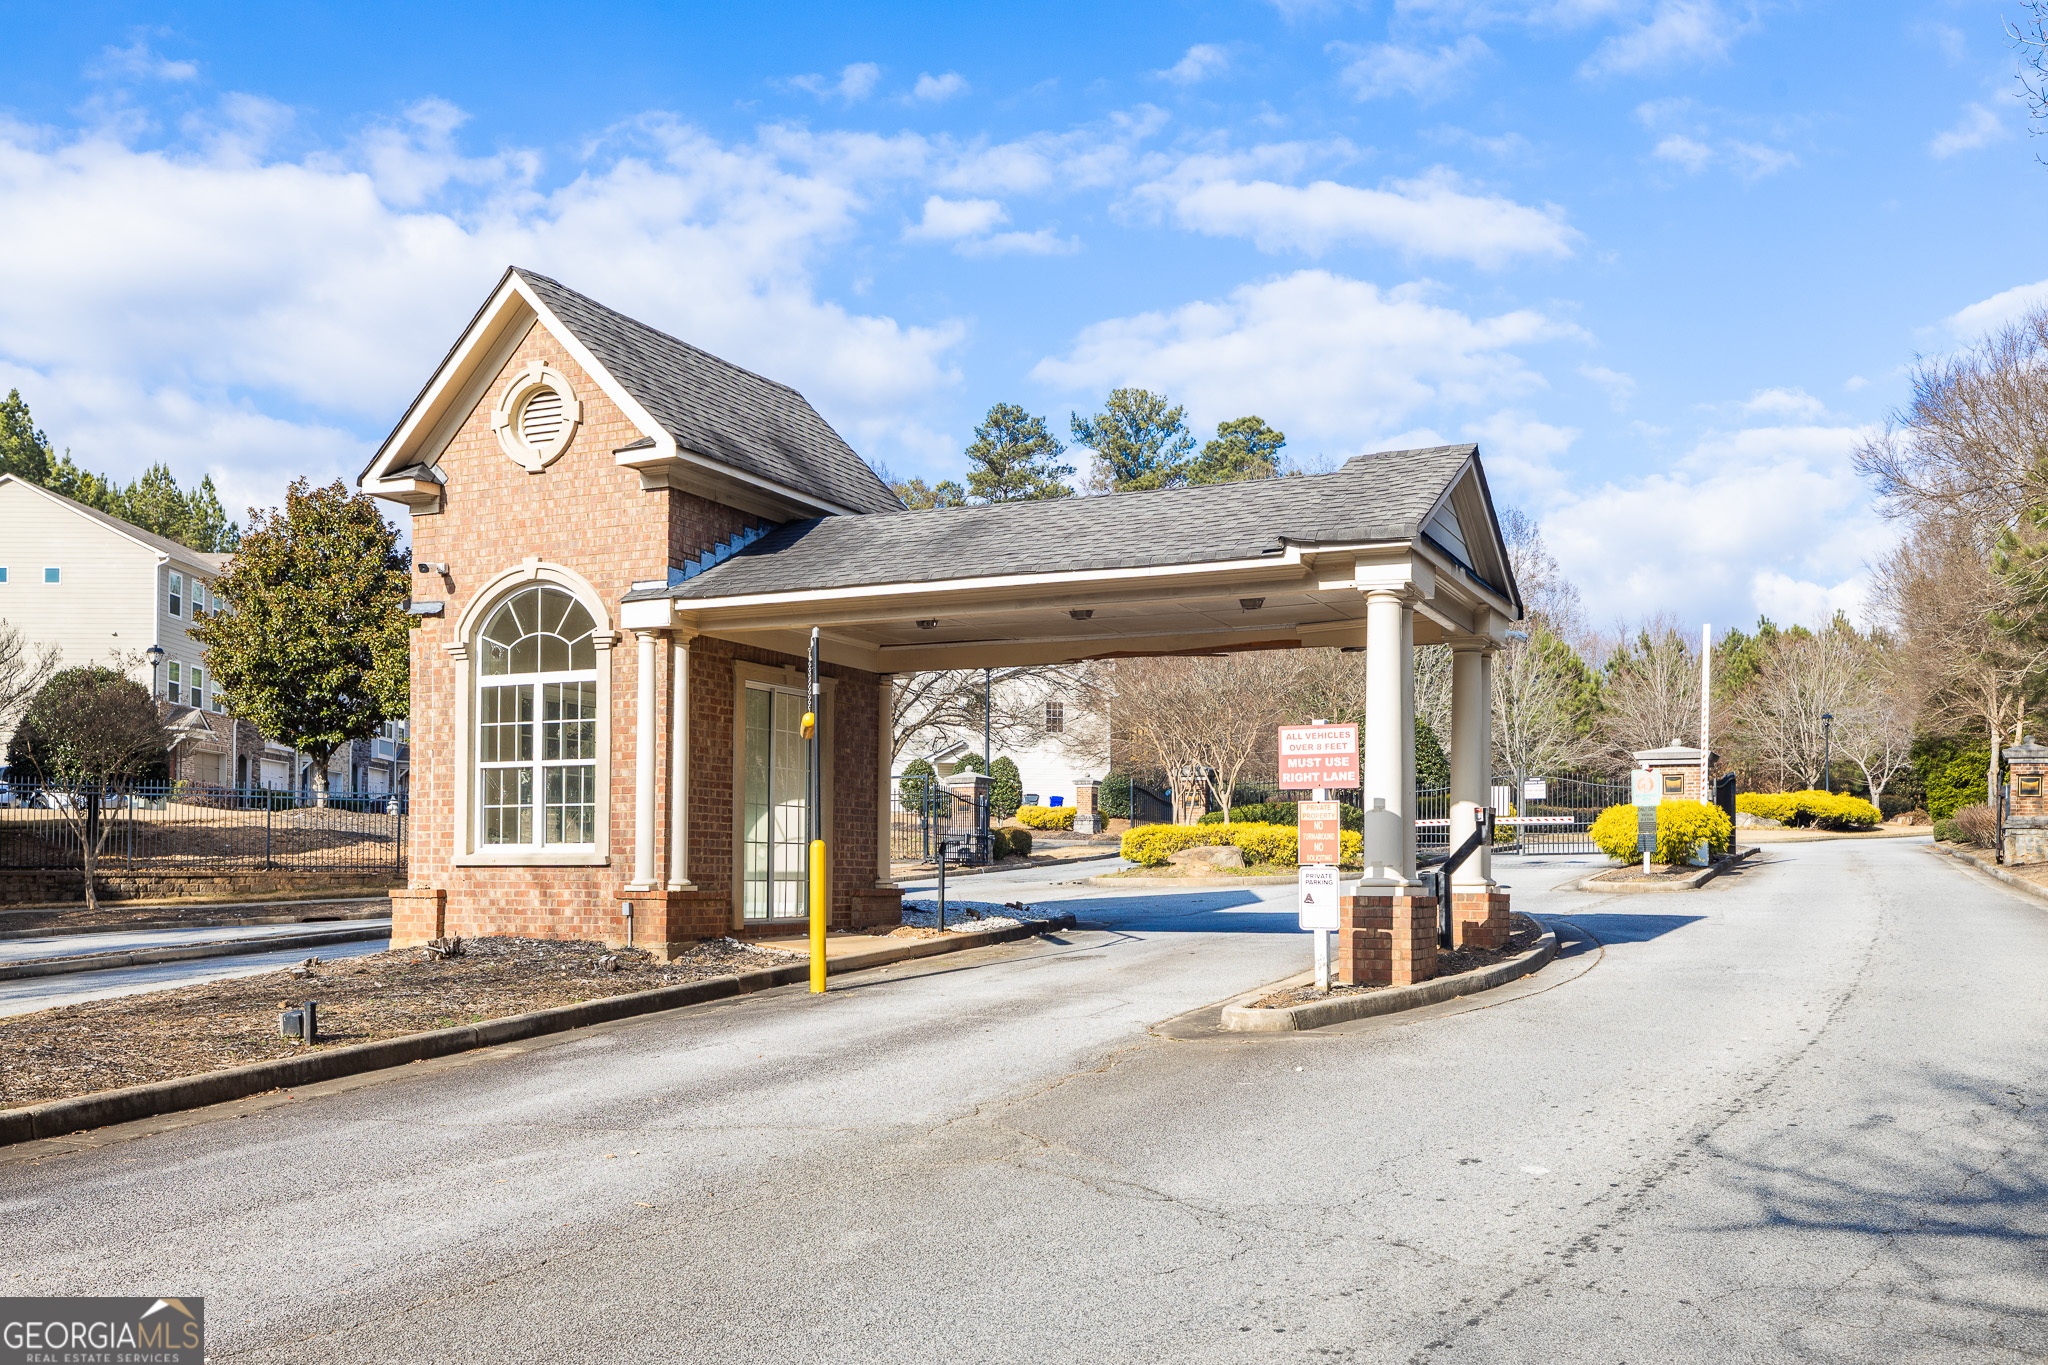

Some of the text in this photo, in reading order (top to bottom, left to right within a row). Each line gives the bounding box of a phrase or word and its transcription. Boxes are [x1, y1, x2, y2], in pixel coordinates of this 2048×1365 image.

[1306, 731, 1350, 740] VEHICLES
[1288, 756, 1350, 768] MUST USE
[1282, 772, 1356, 782] RIGHT LANE
[1314, 820, 1324, 830] NO
[1314, 842, 1324, 852] NO
